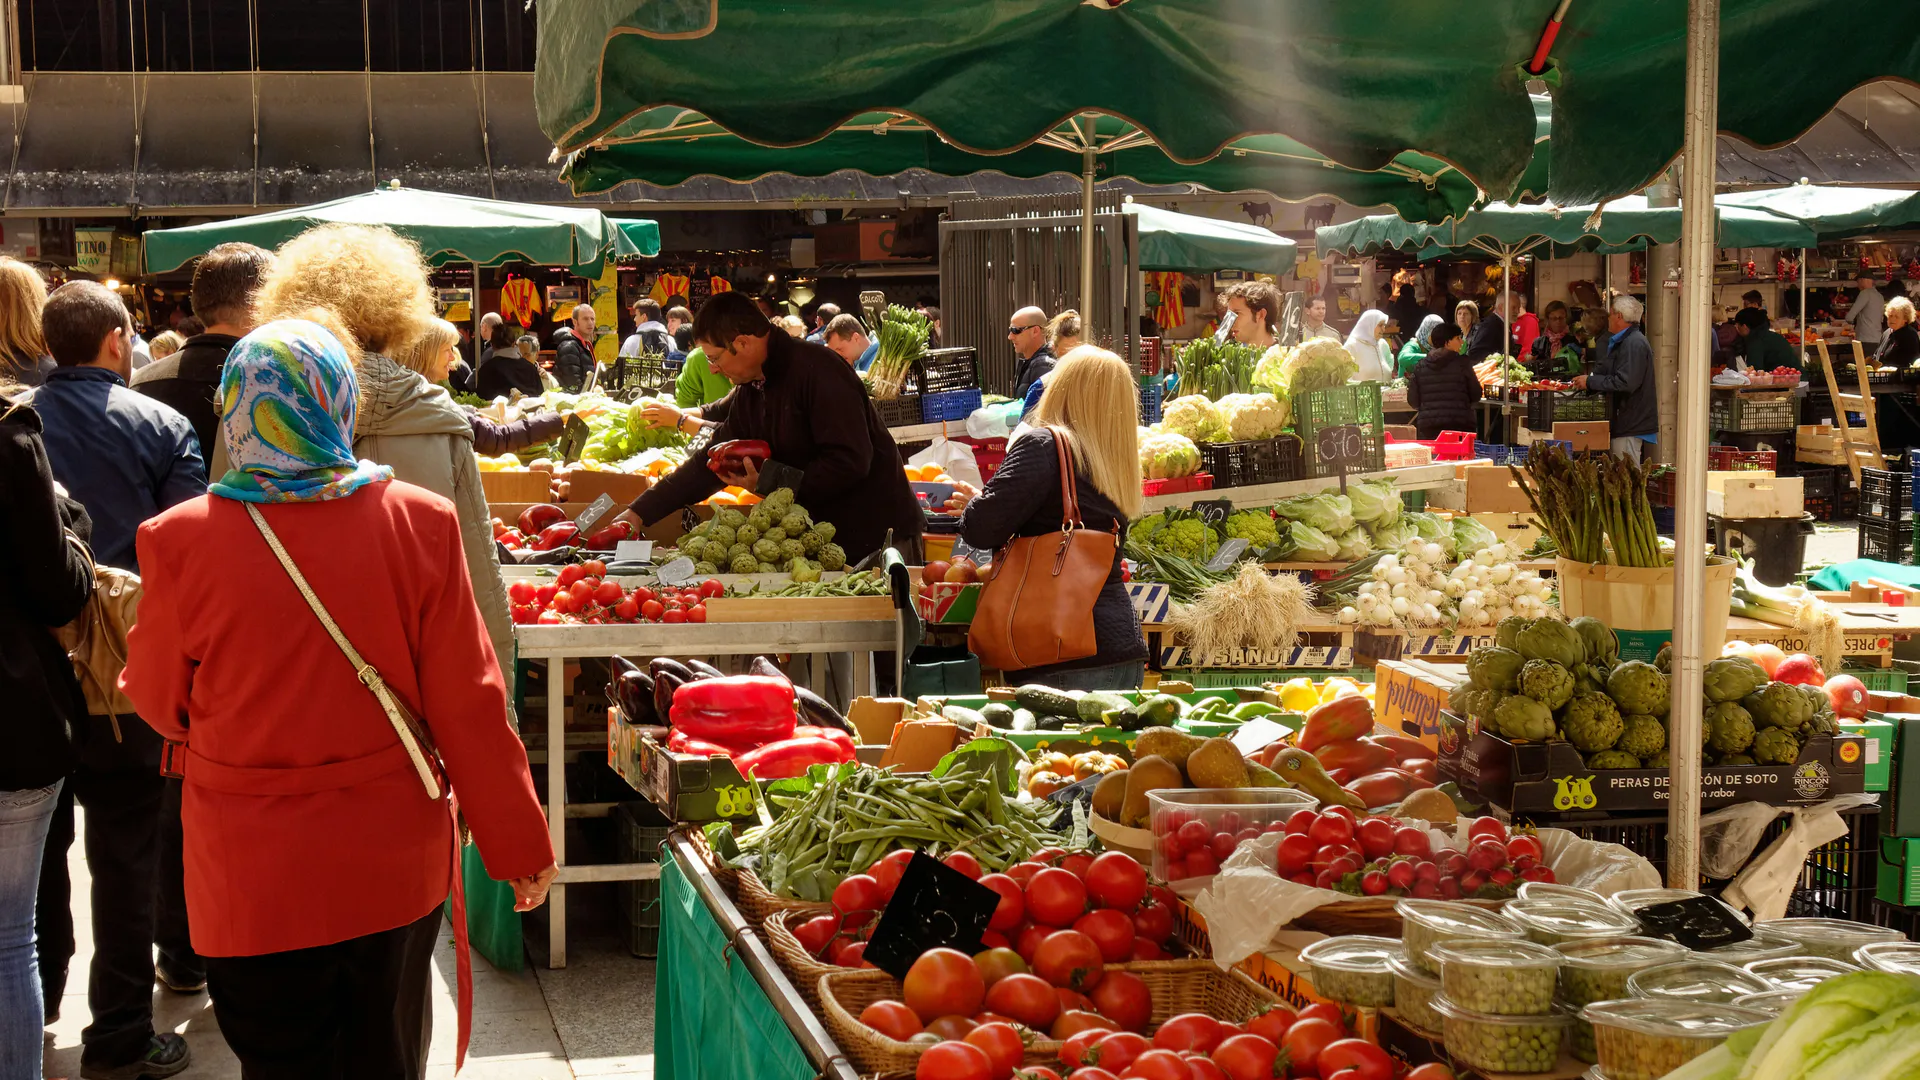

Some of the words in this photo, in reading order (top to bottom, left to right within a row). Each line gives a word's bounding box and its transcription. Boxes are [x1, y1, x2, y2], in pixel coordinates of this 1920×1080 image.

[1610, 778, 1650, 788] PERAS
[1654, 777, 1670, 787] DE
[1726, 774, 1742, 785] DE
[1745, 774, 1778, 784] SOTO
[1709, 788, 1736, 798] sabor
